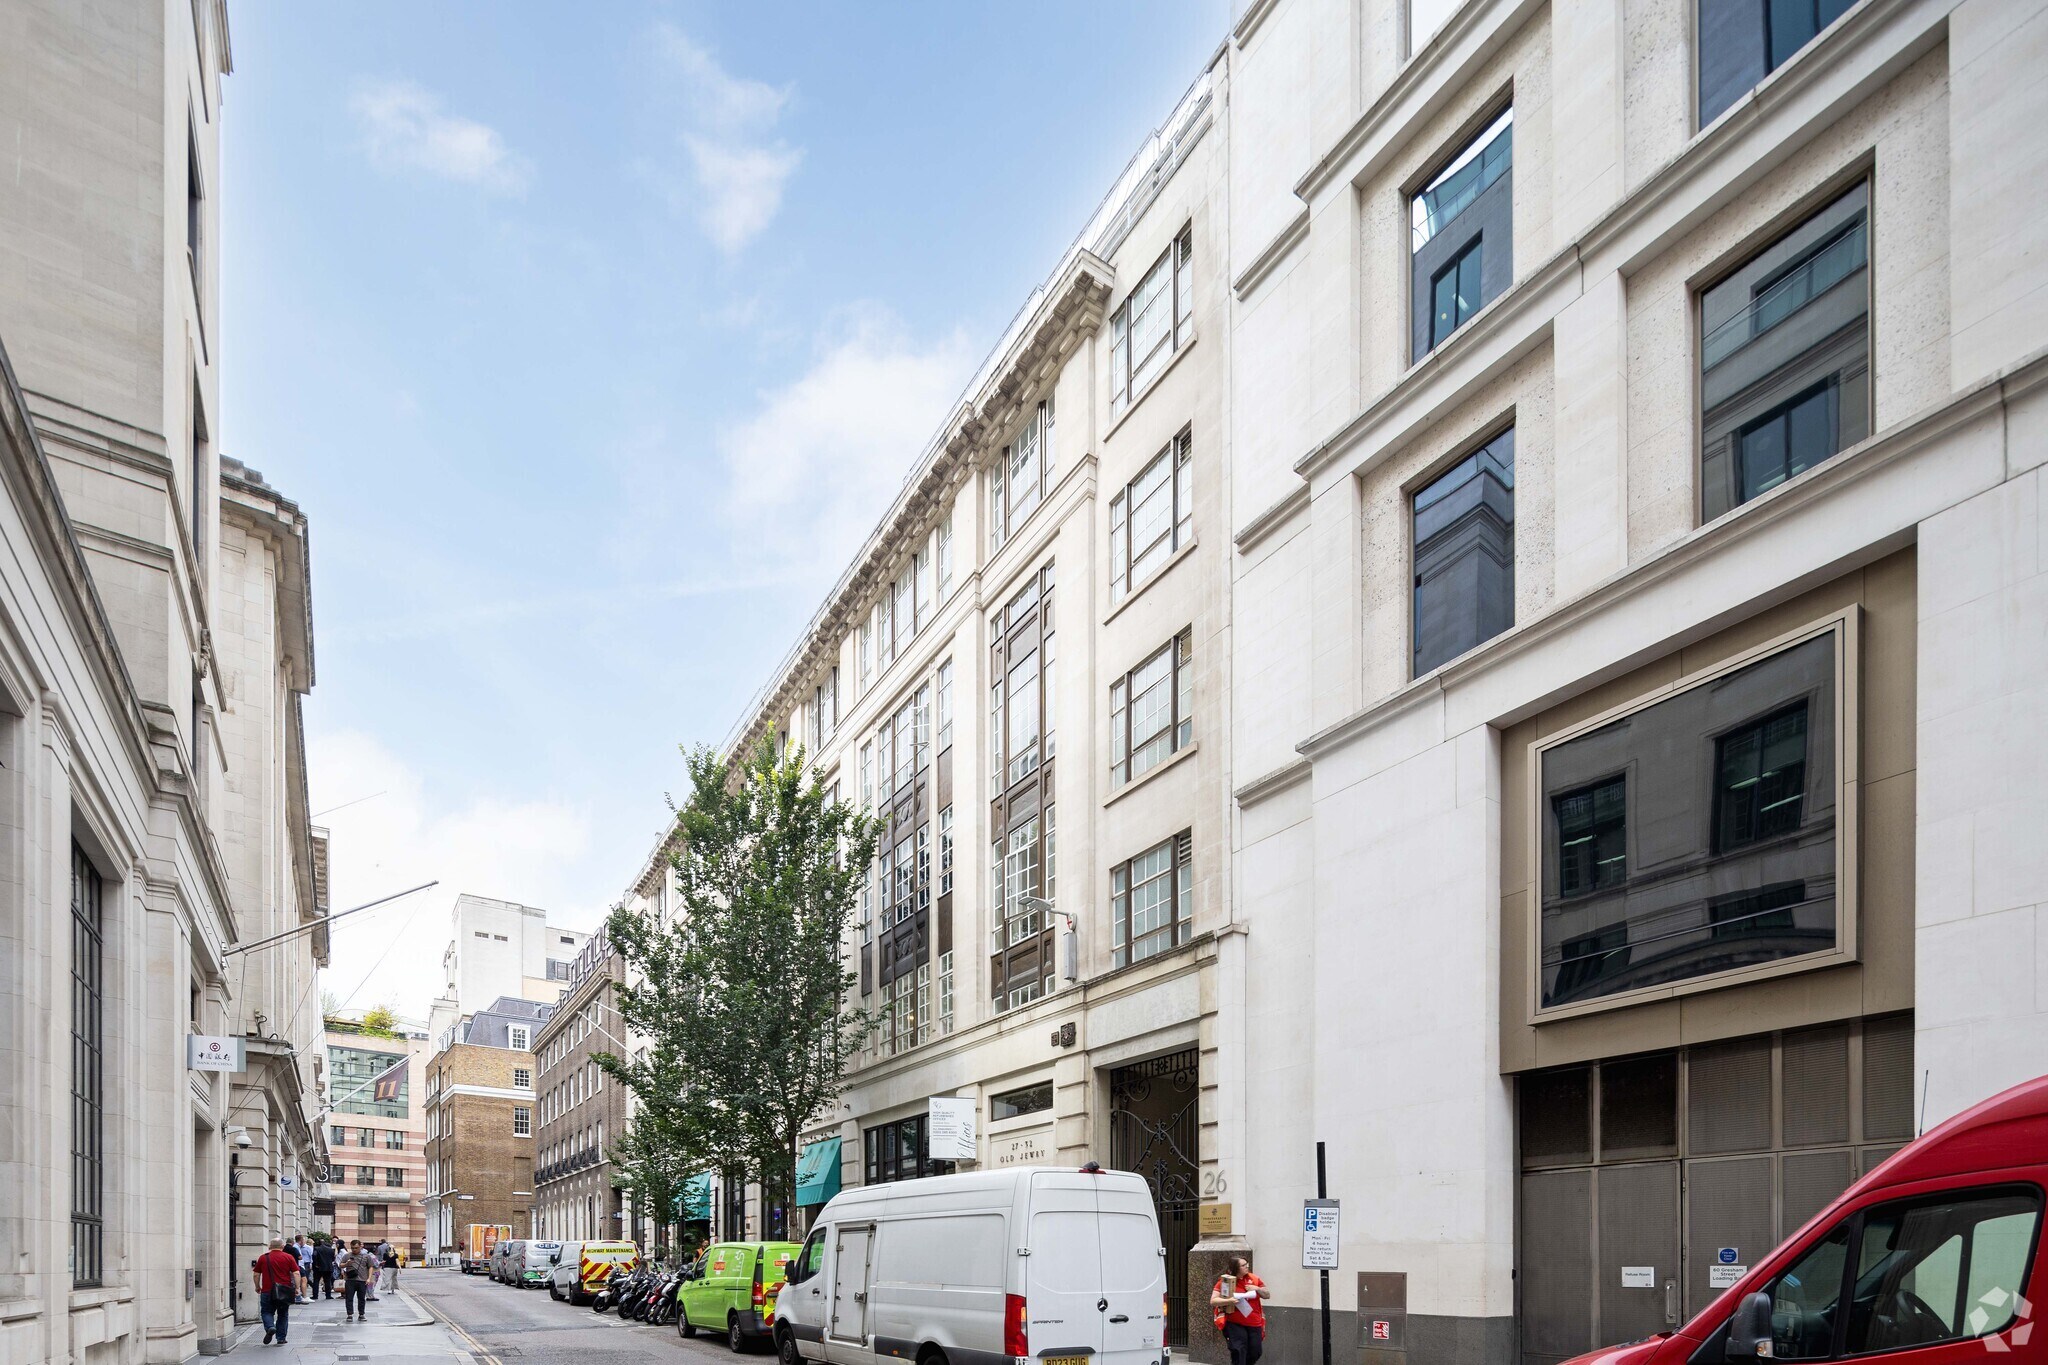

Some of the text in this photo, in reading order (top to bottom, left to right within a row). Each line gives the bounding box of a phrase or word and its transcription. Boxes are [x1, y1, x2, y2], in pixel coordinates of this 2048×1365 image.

[376, 1080, 397, 1099] 11
[999, 1149, 1045, 1163] OLD JEWRY
[1204, 1169, 1227, 1195] 26
[1308, 1210, 1316, 1219] P
